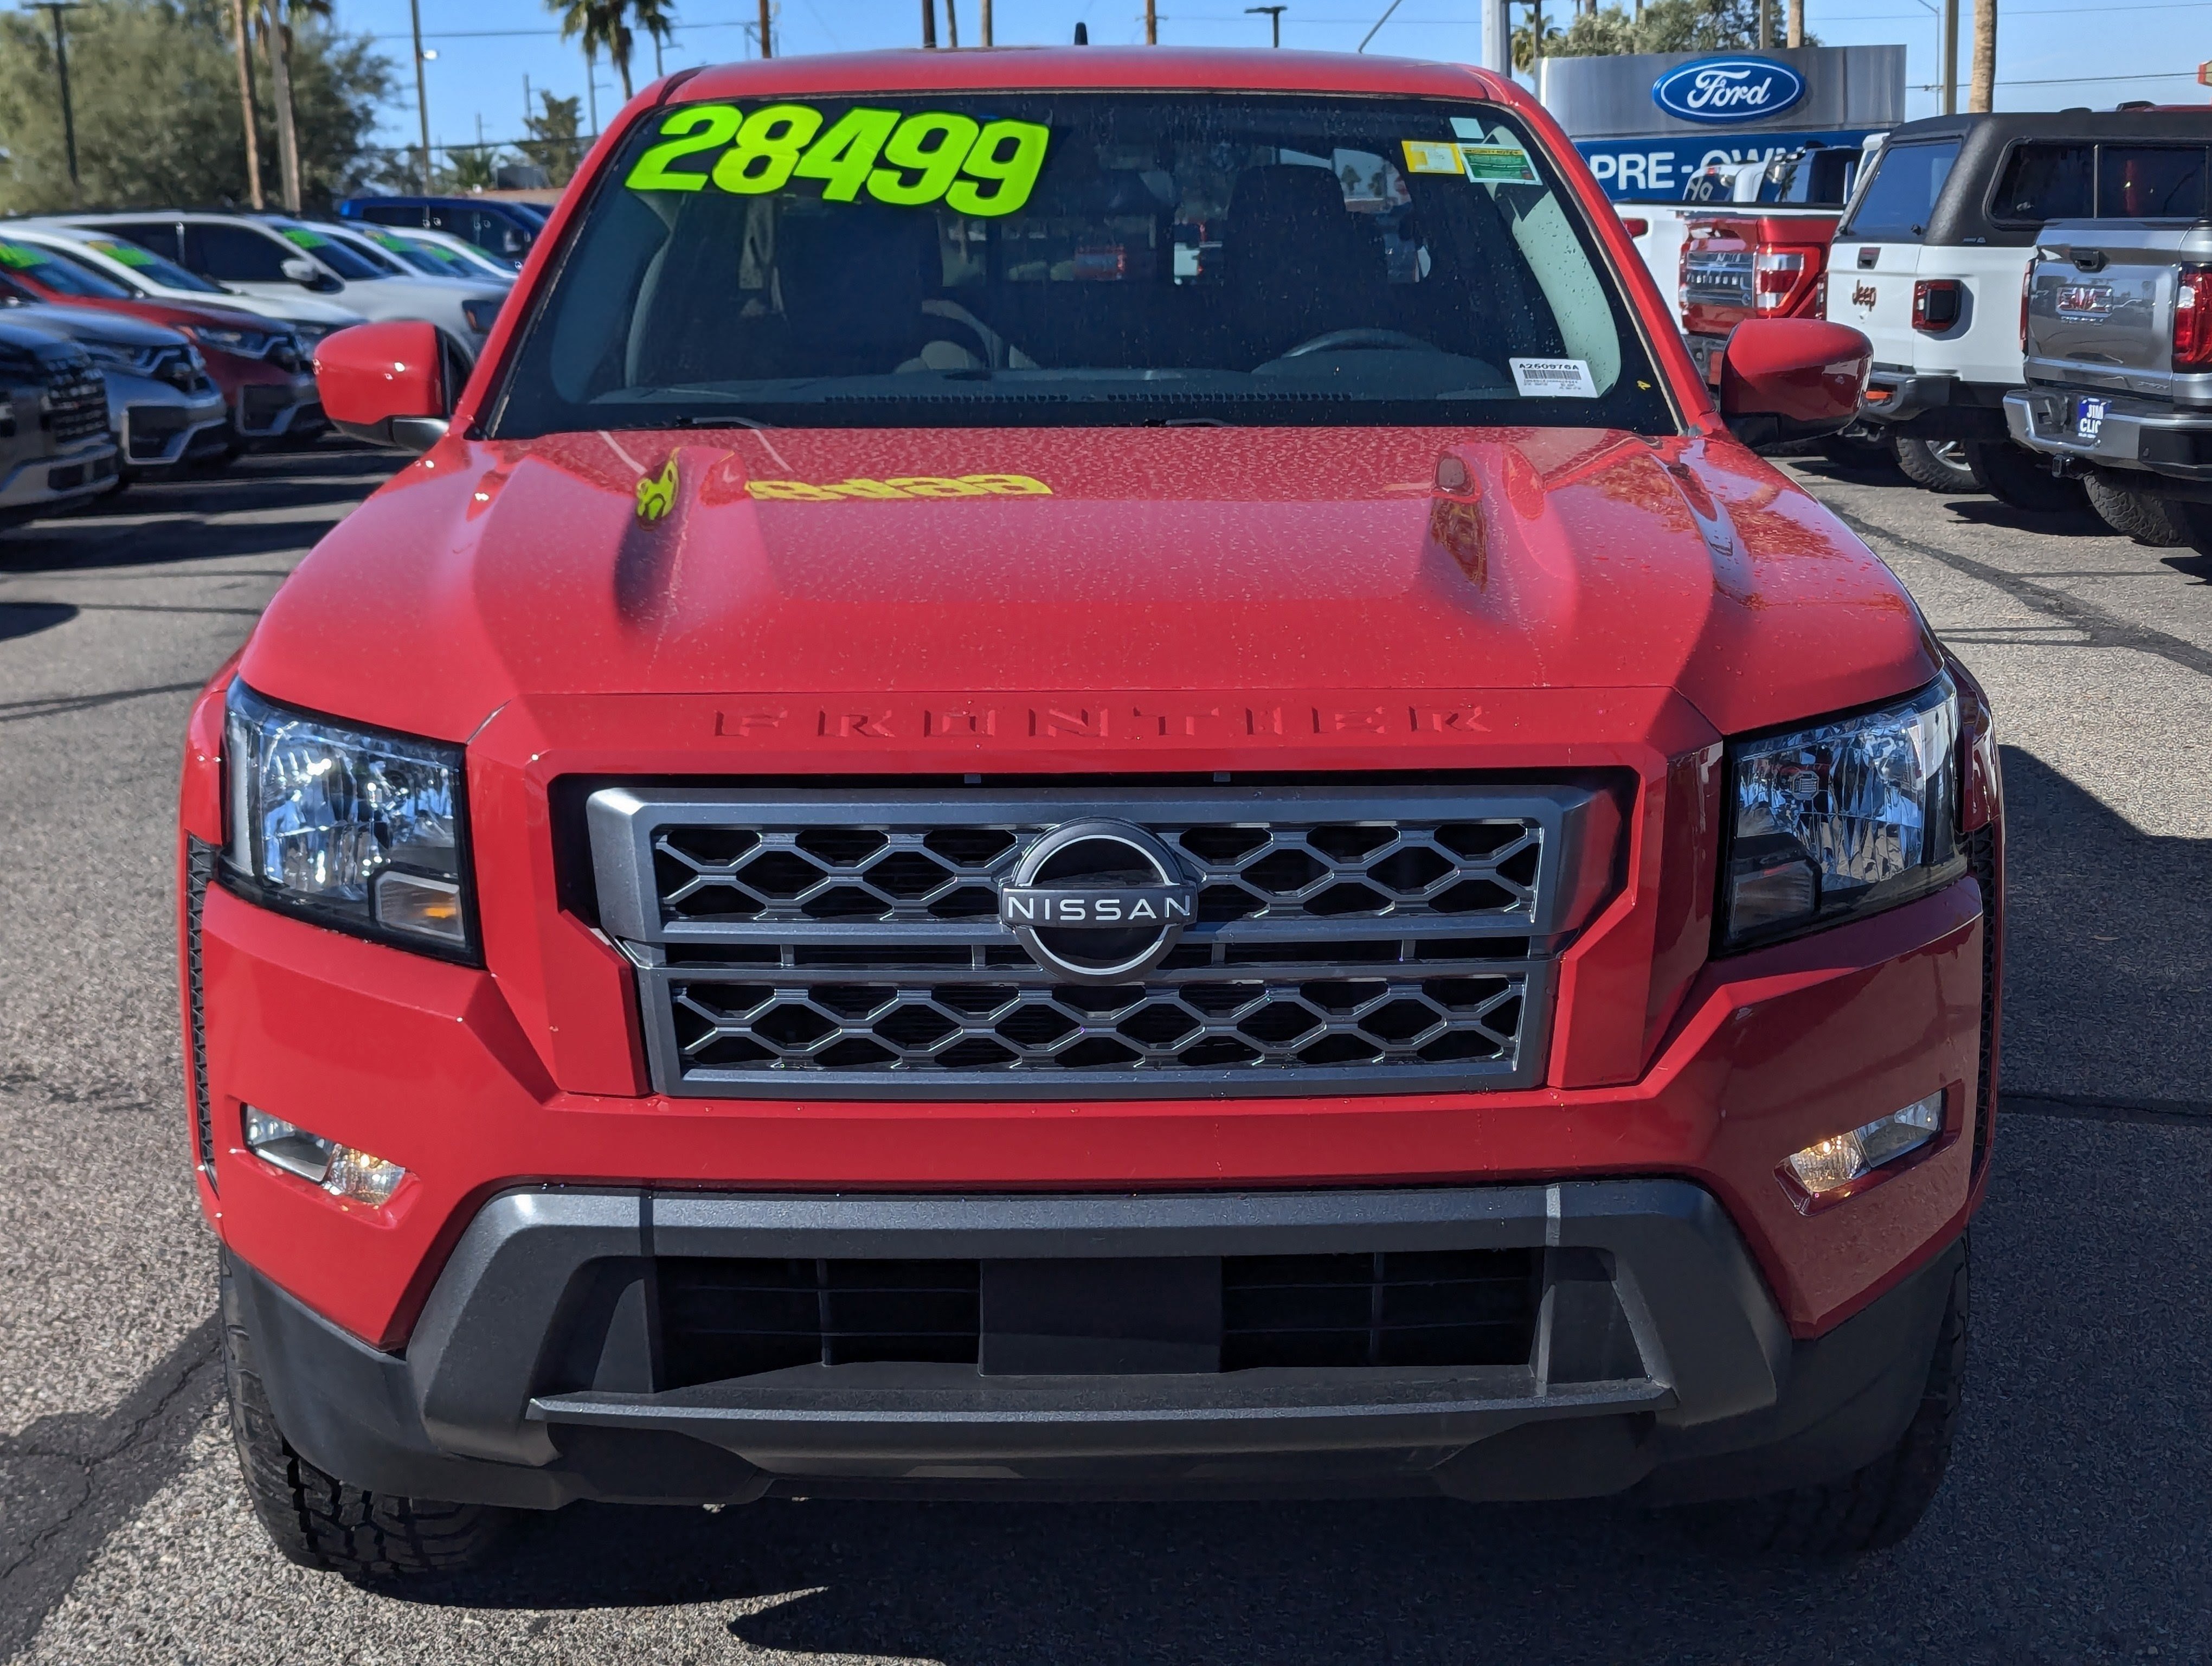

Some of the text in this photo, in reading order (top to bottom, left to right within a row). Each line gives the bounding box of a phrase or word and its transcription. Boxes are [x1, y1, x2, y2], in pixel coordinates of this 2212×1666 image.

[1687, 69, 1772, 108] Ford
[625, 104, 1051, 216] 28499
[1590, 146, 1804, 190] PRE-
[1852, 279, 1876, 312] Jeep
[2086, 404, 2104, 419] JIM
[713, 706, 1493, 738] FRONTIER
[1007, 895, 1191, 921] NISSAN
